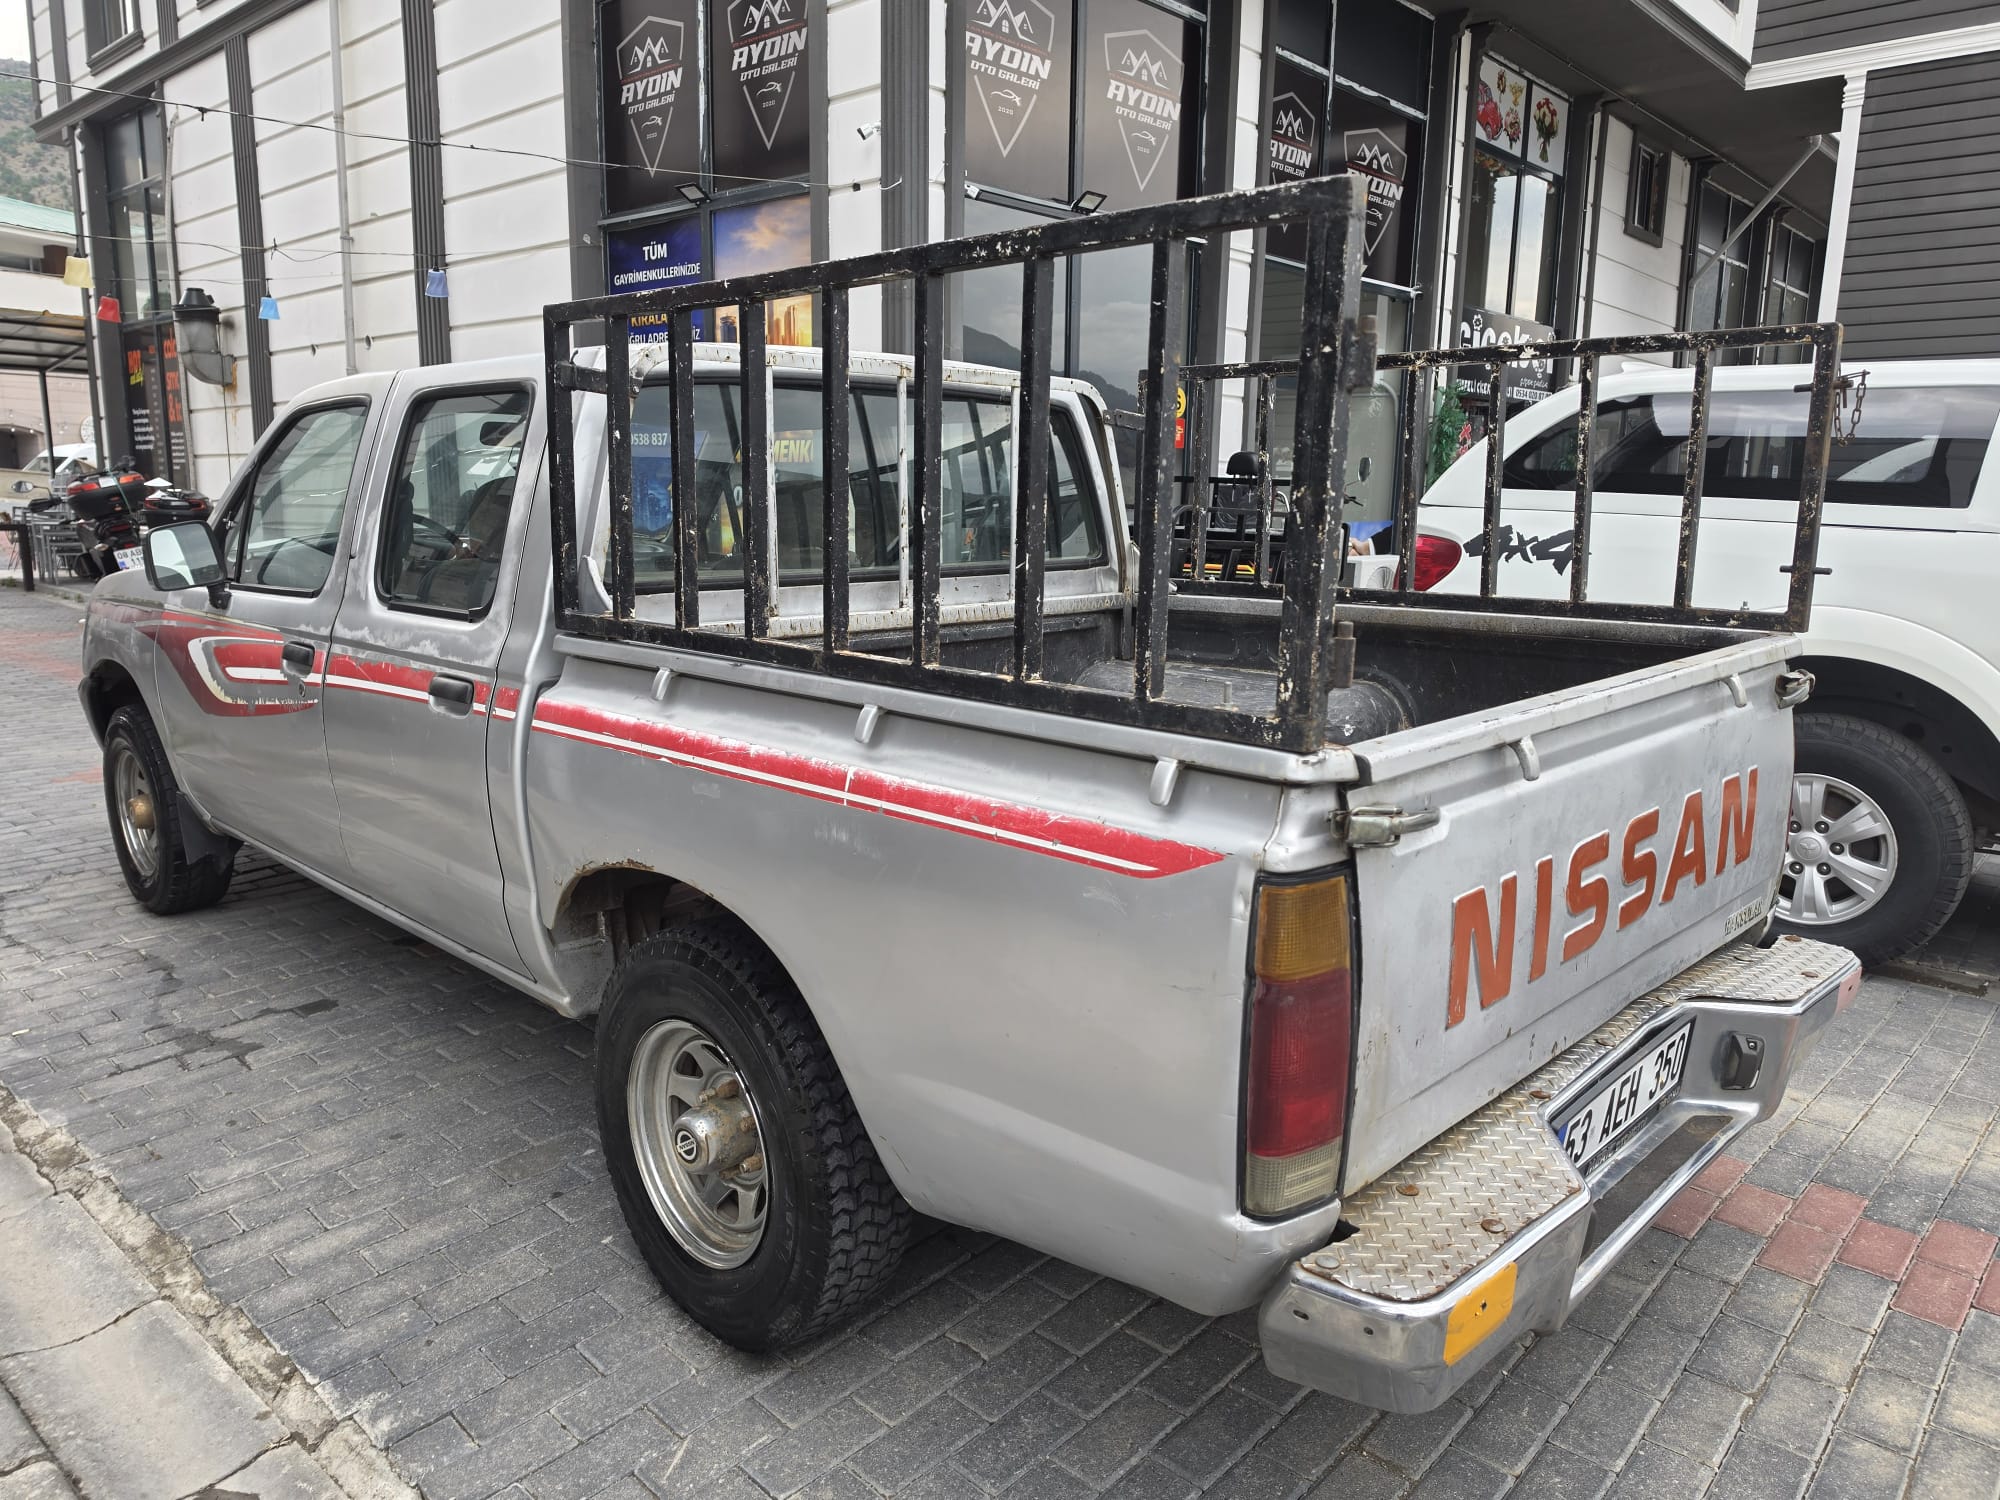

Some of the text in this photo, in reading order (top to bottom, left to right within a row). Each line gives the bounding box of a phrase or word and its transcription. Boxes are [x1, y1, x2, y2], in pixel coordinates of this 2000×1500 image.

[731, 27, 808, 71] AYDIN
[966, 31, 1051, 79] AYDIN
[740, 53, 798, 81] OTO GALERİ
[970, 60, 1040, 90] OTO GALERİ
[620, 66, 683, 105] AYDIN
[1106, 79, 1181, 121] AYDIN
[628, 91, 675, 115] OTO GALERİ
[1115, 105, 1172, 131] OTO GALERİ
[1271, 160, 1284, 171] OTO
[642, 241, 668, 261] TÜM
[614, 262, 701, 287] GAYRİMENKULLERİNİZDE
[651, 432, 668, 446] 837
[1446, 765, 1759, 1030] NISSAN
[1565, 1108, 1593, 1163] 53
[1599, 1065, 1643, 1144] AEH
[1649, 1032, 1686, 1101] 350
